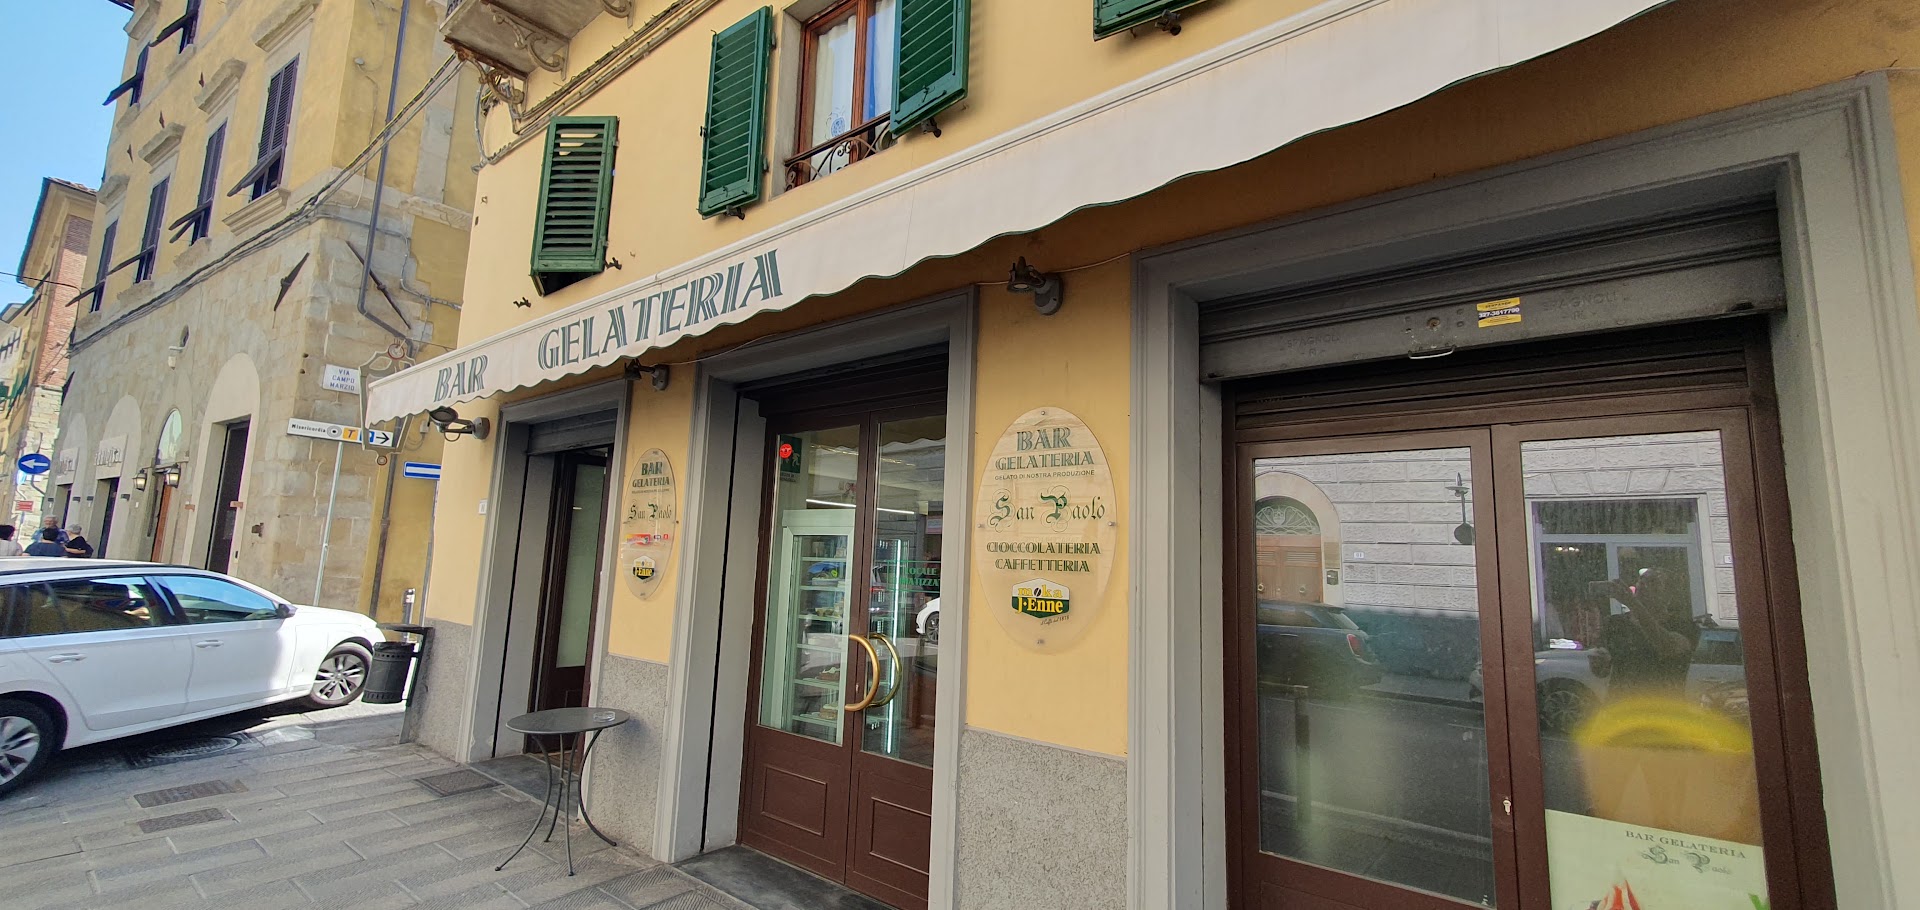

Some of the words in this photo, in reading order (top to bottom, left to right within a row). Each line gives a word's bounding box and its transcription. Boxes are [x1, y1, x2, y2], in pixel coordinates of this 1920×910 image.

[433, 354, 489, 403] BAR
[537, 248, 784, 371] GELATERIA
[329, 381, 355, 391] MARZIO
[332, 375, 355, 384] CAMPO
[291, 424, 326, 433] Misericordia
[1016, 427, 1071, 451] BAR
[995, 450, 1095, 471] GELATERIA
[641, 461, 663, 476] BAR
[995, 472, 1018, 481] GELATO
[1018, 472, 1026, 480] DI
[1053, 469, 1095, 478] PRODUZIONE
[632, 476, 670, 488] GELATERIA
[628, 502, 646, 520] San
[988, 491, 1035, 529] San
[986, 541, 1101, 555] CIOCCOLATERIA
[905, 567, 938, 576] LOCALE
[995, 558, 1090, 573] CAFFETTERIA
[1625, 830, 1655, 842] BAR
[1659, 836, 1747, 859] GELATERIA
[1641, 845, 1680, 865] San
